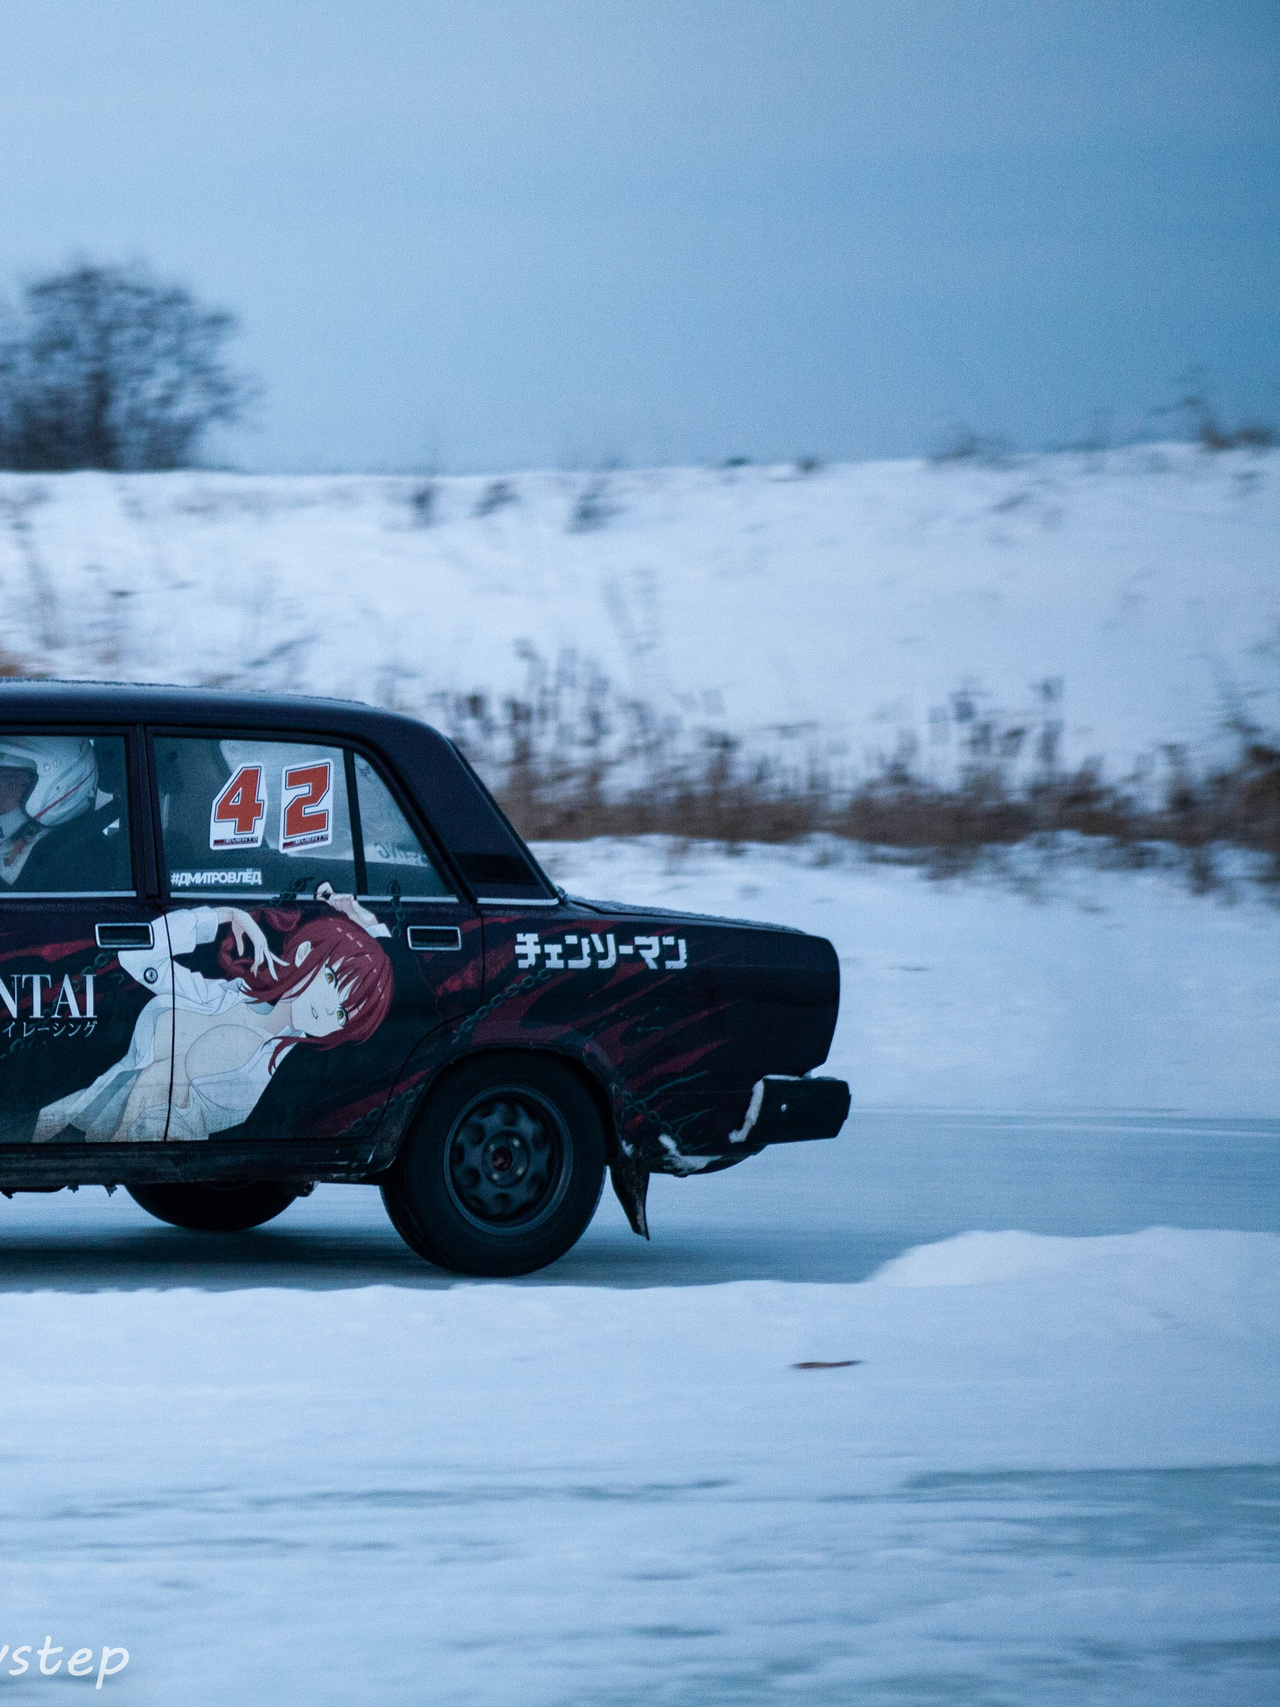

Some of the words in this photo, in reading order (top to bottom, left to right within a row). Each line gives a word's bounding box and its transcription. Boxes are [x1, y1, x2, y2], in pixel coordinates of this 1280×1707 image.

[170, 868, 263, 887] #ДМИТРОВЛЁД
[515, 932, 688, 970] チェンソーマン
